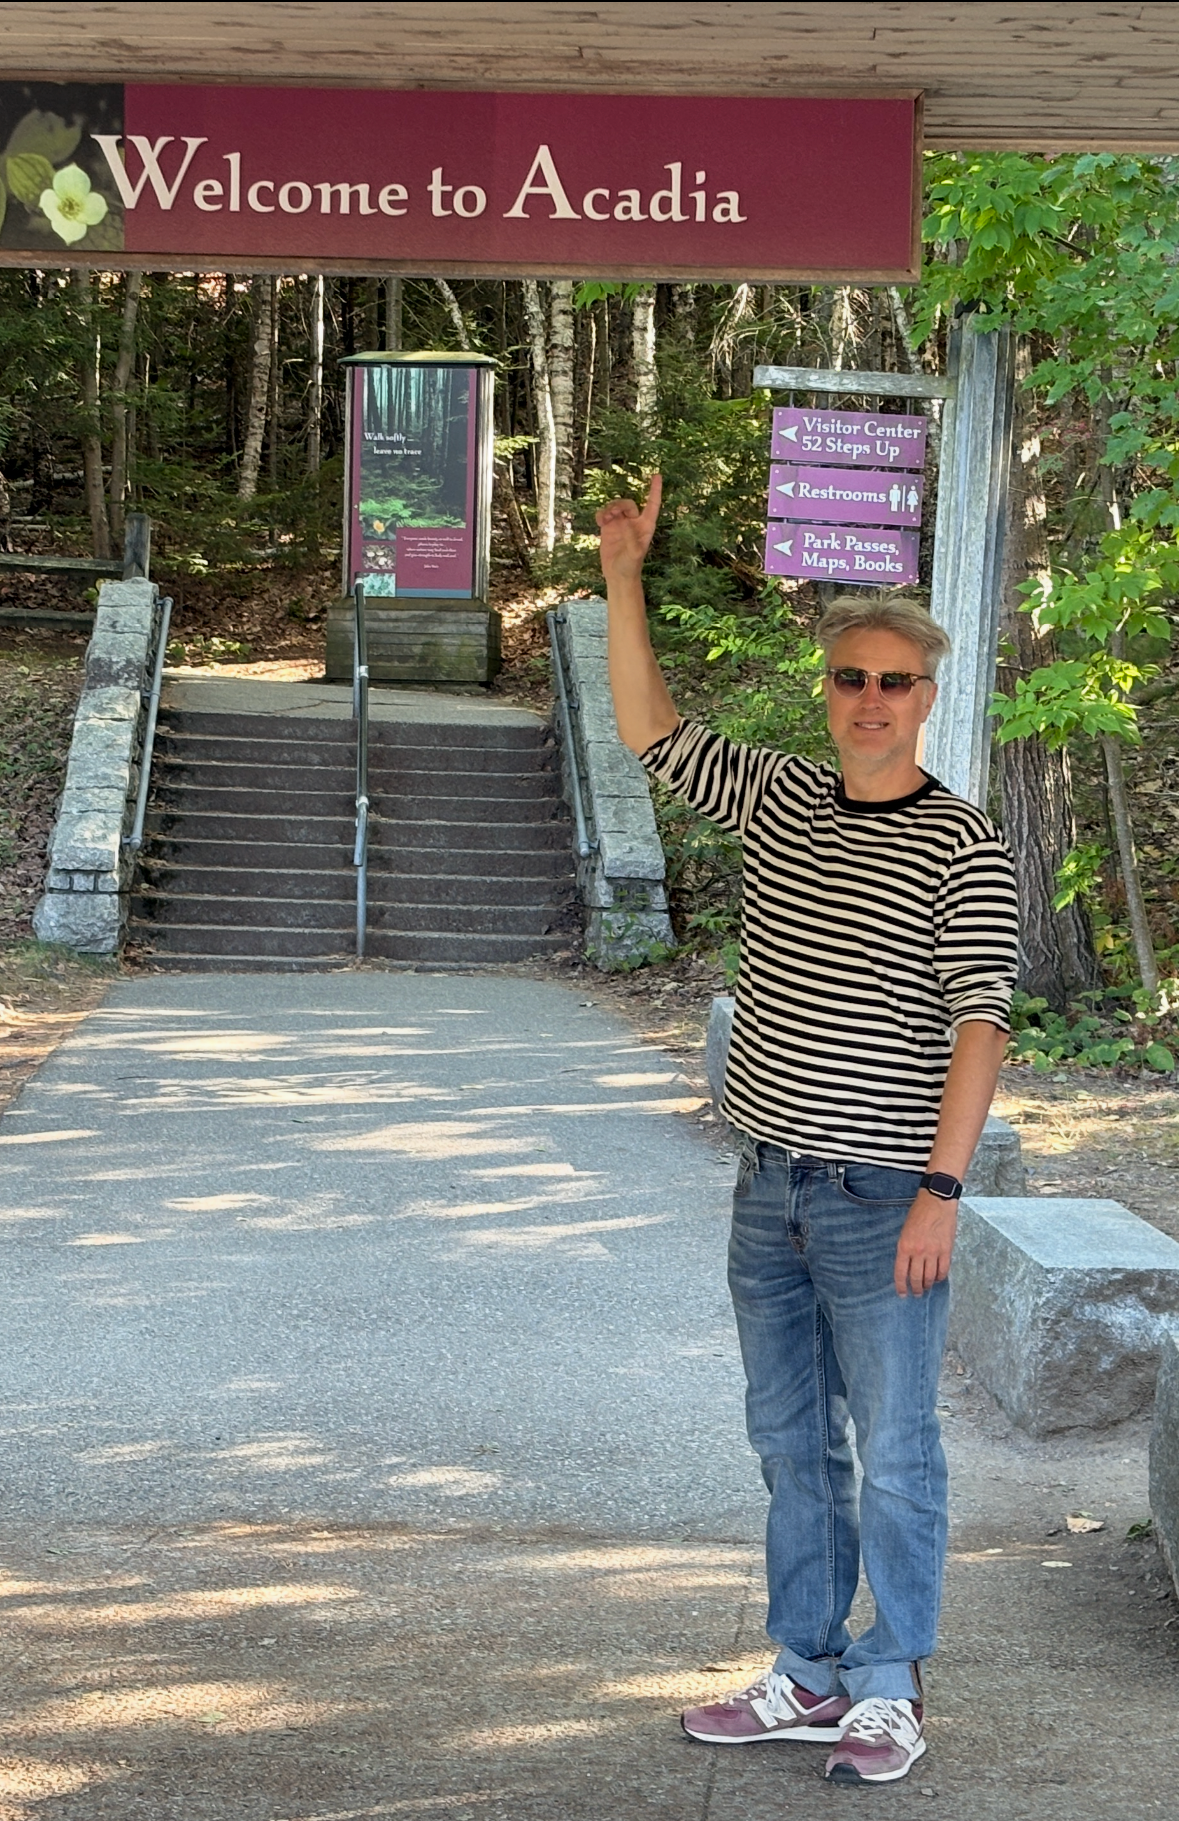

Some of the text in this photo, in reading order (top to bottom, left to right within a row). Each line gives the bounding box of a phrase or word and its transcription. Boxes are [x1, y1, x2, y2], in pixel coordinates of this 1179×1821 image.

[90, 134, 747, 224] Welcome to Acadia
[364, 432, 406, 444] Walk softly
[803, 417, 921, 439] Visitor Center
[373, 446, 391, 455] leave
[404, 448, 422, 456] trace
[801, 436, 900, 462] 52 Steps Up
[799, 482, 886, 503] Restrooms
[803, 532, 899, 555] Park Passes,
[801, 552, 903, 574] Maps, Books
